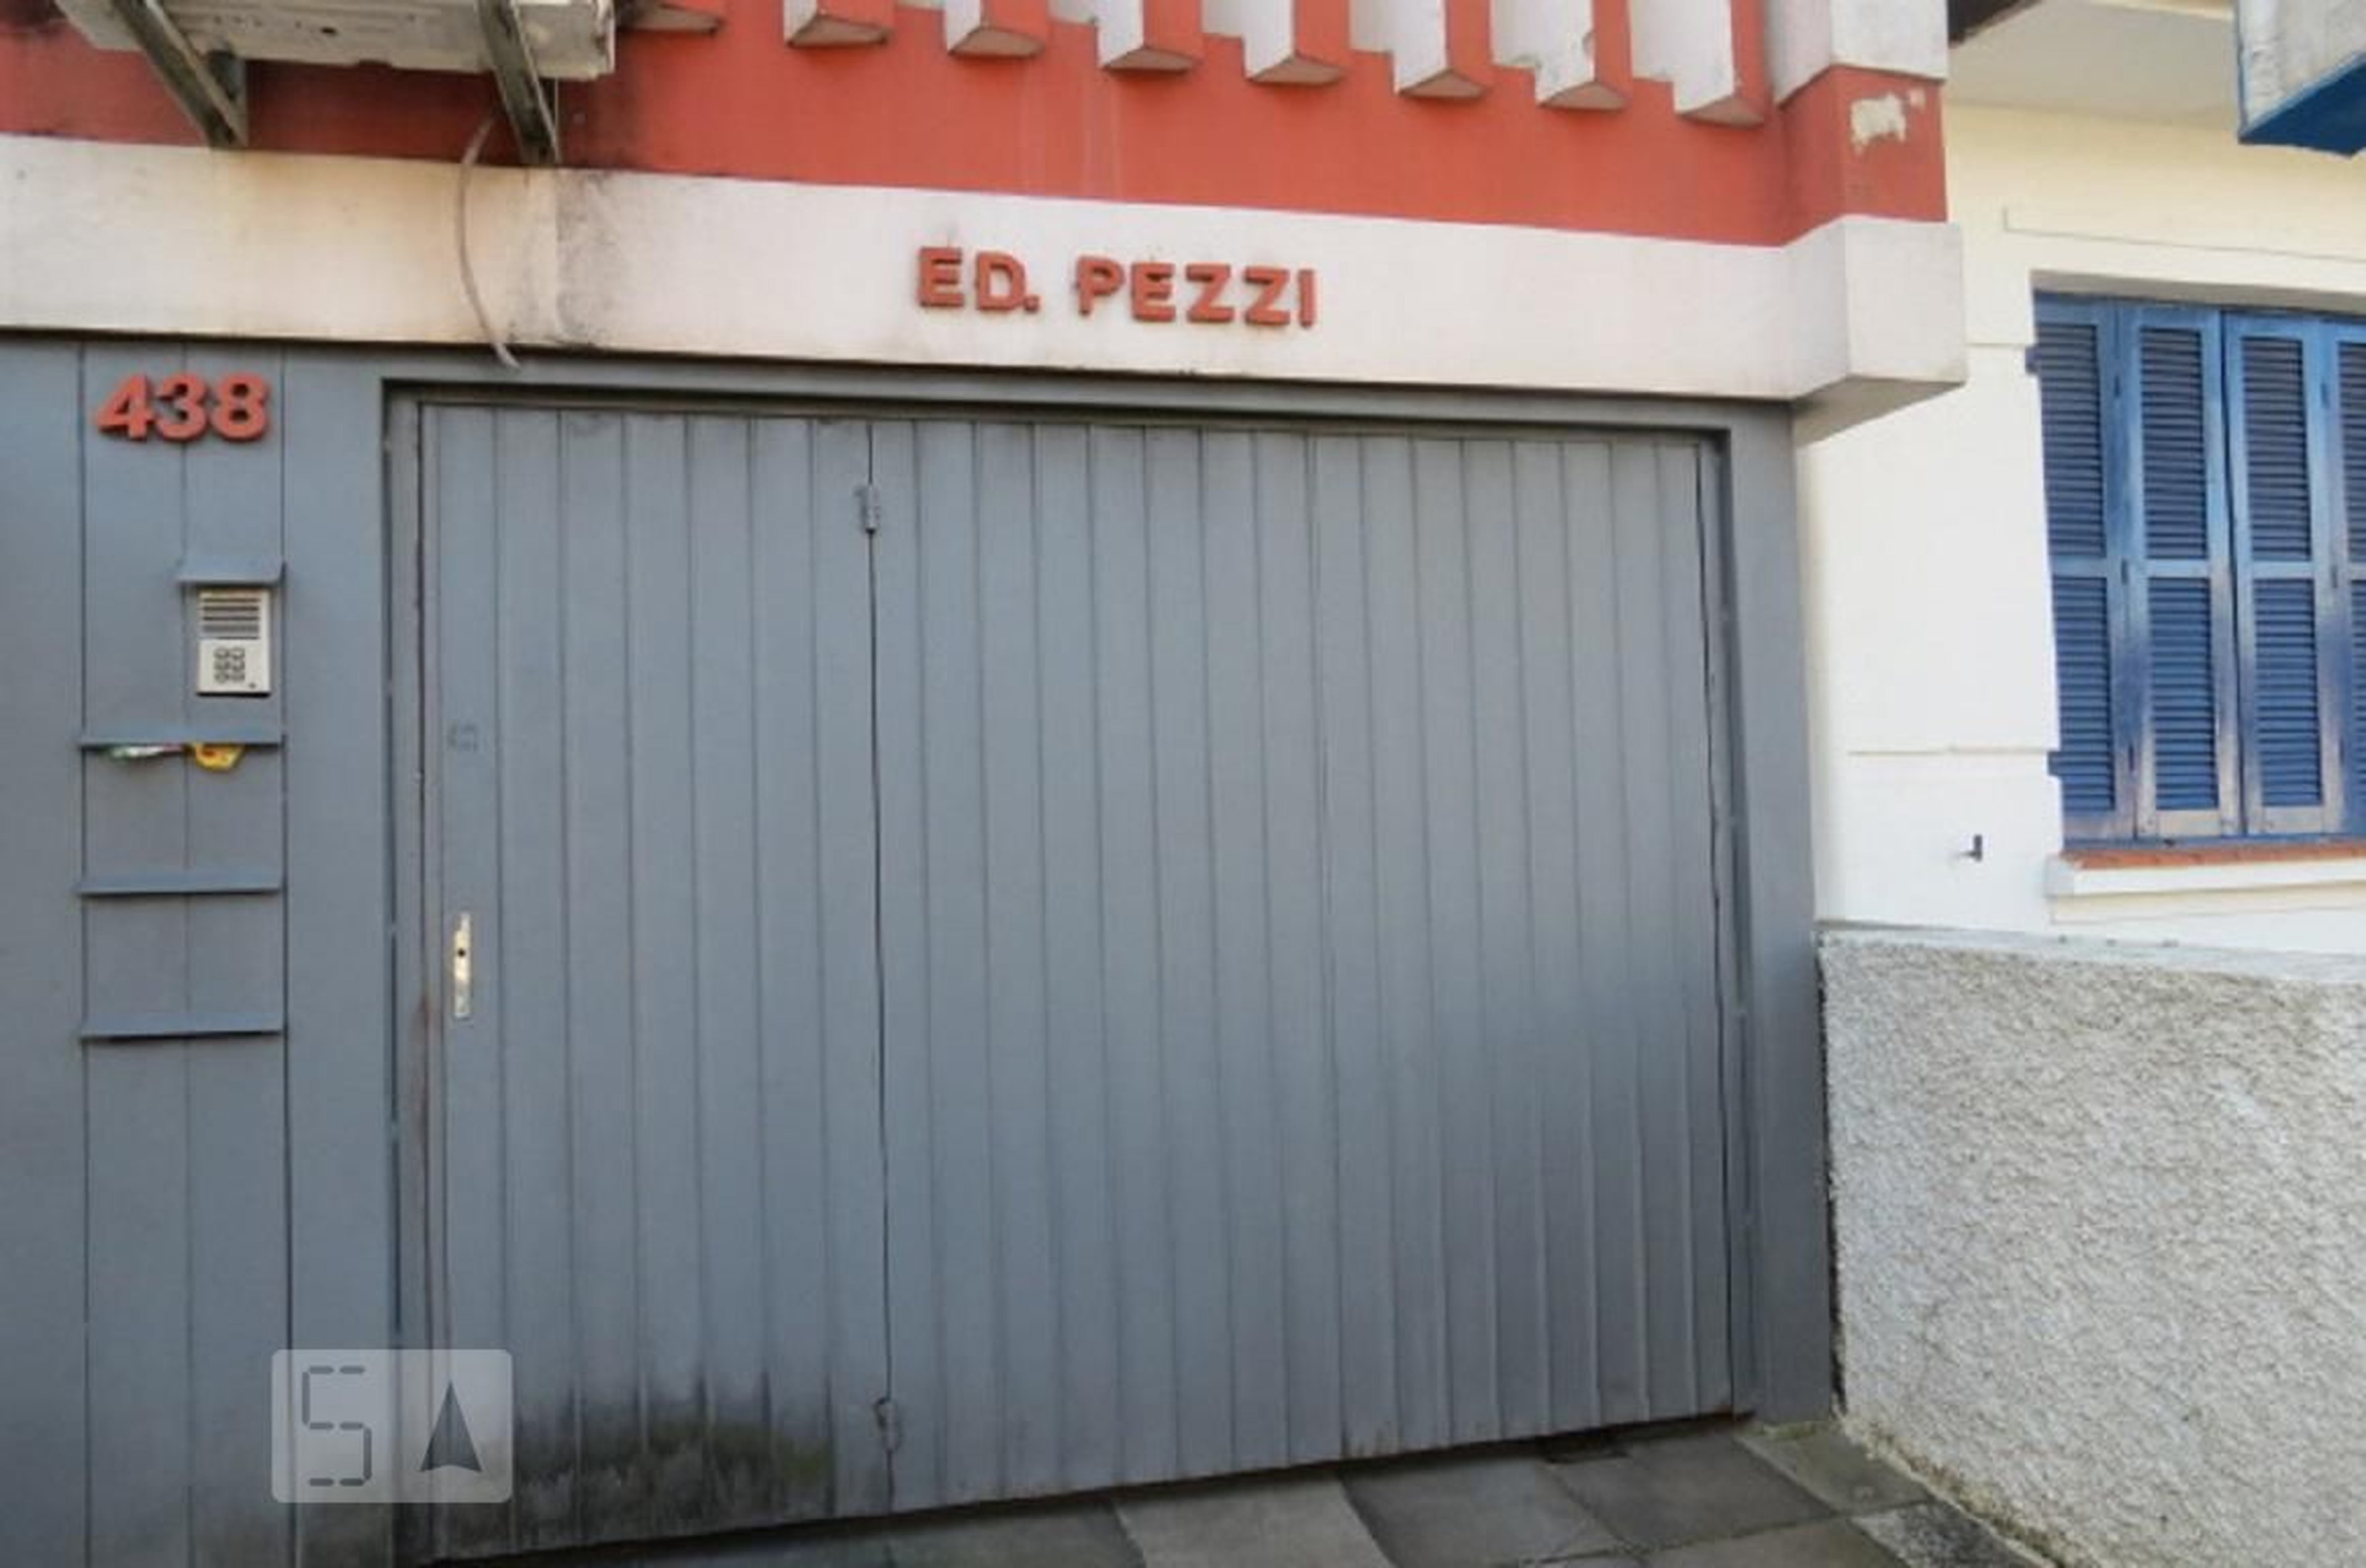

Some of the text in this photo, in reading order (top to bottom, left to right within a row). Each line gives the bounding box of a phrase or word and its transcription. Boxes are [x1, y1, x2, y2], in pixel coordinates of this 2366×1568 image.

[917, 246, 1317, 328] ED. PEZZI
[97, 373, 269, 440] 438
